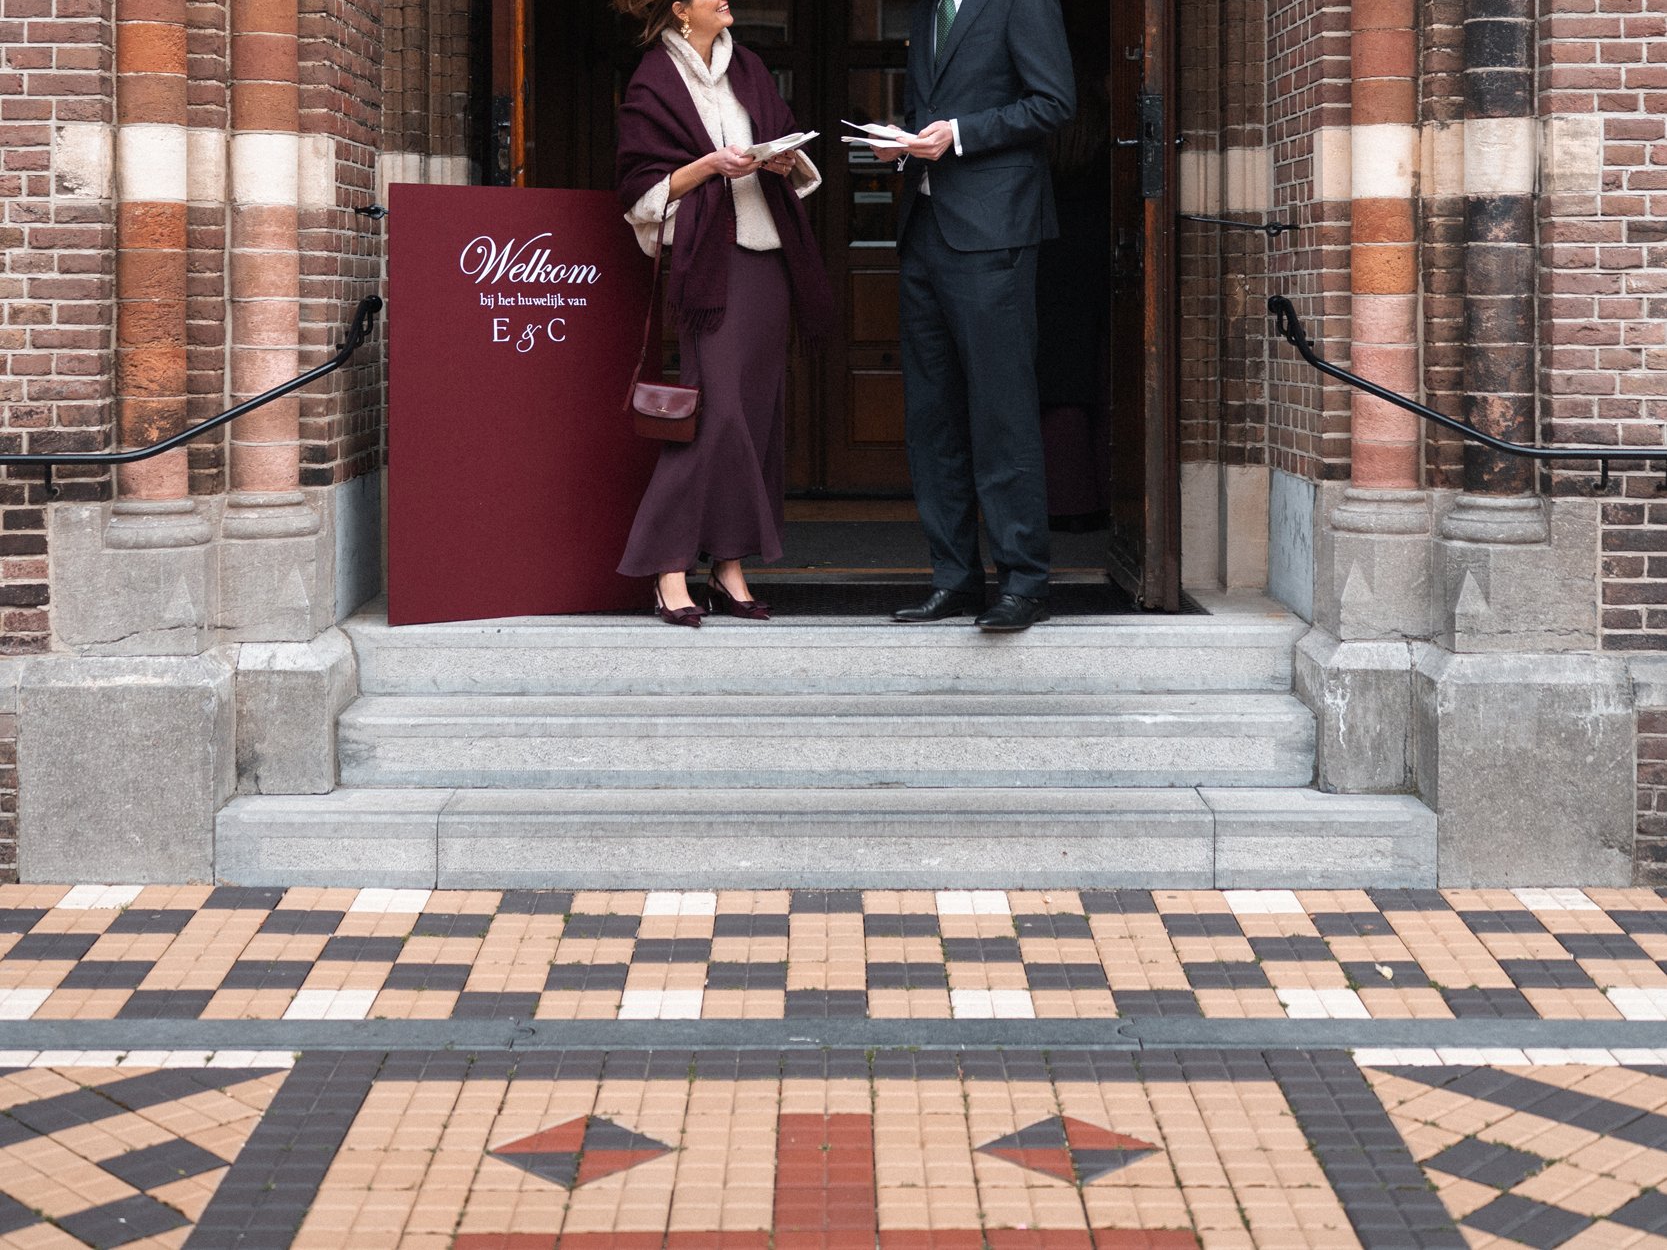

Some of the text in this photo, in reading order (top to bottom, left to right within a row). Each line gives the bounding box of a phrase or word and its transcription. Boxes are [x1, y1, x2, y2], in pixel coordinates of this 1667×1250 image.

[459, 232, 602, 285] Welkom
[479, 292, 587, 309] bij het huwelijk van
[492, 317, 566, 353] E & C
